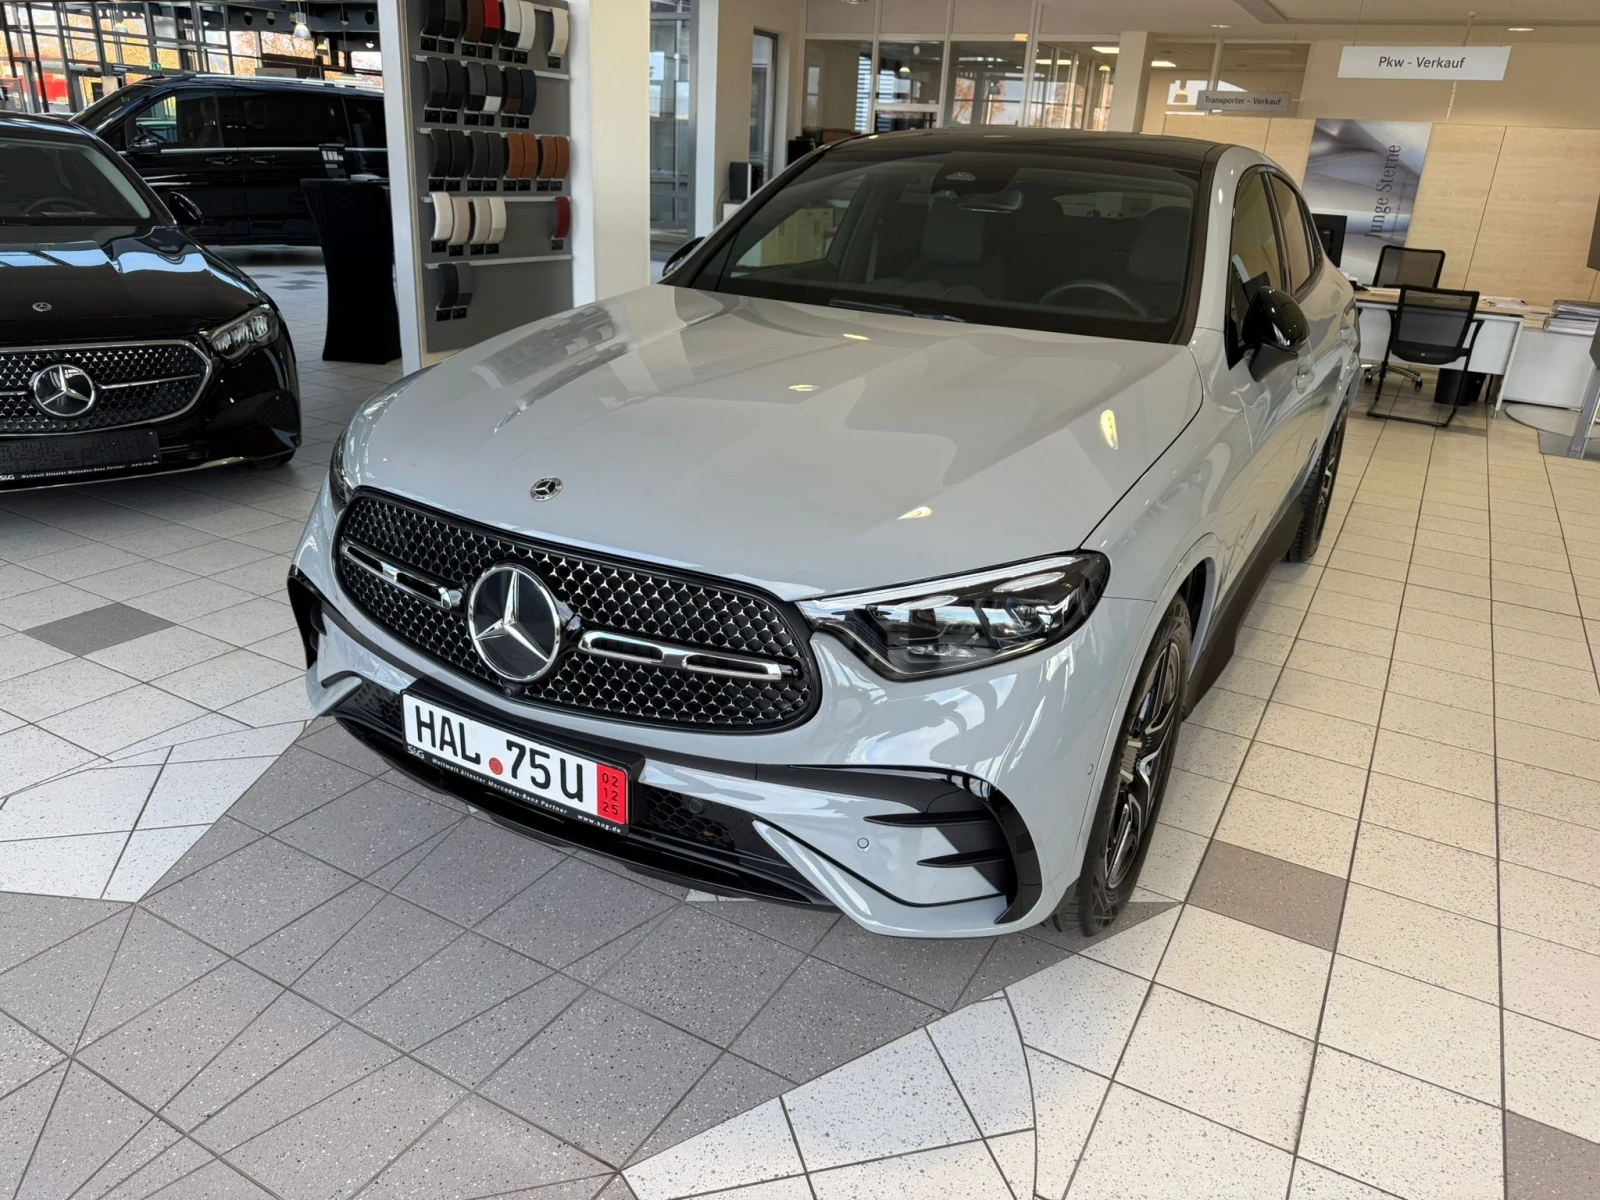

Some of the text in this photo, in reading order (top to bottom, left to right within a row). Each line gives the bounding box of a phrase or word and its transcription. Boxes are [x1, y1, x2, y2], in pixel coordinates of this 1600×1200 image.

[1378, 56, 1405, 68] Pkw
[1416, 56, 1466, 69] Verkauf
[1205, 96, 1246, 107] Transporter
[1253, 97, 1282, 106] Verkauf
[1375, 145, 1401, 193] Sterne
[1365, 197, 1392, 239] Junge
[415, 705, 481, 765] HAL
[602, 773, 618, 787] 02
[431, 757, 459, 774] Weltweit
[460, 769, 486, 784] ältester
[488, 779, 539, 804] Mercedes-Benz
[541, 800, 568, 815] Partner
[577, 814, 621, 833] www.sug.de
[603, 787, 618, 801] 12
[602, 801, 619, 816] 25
